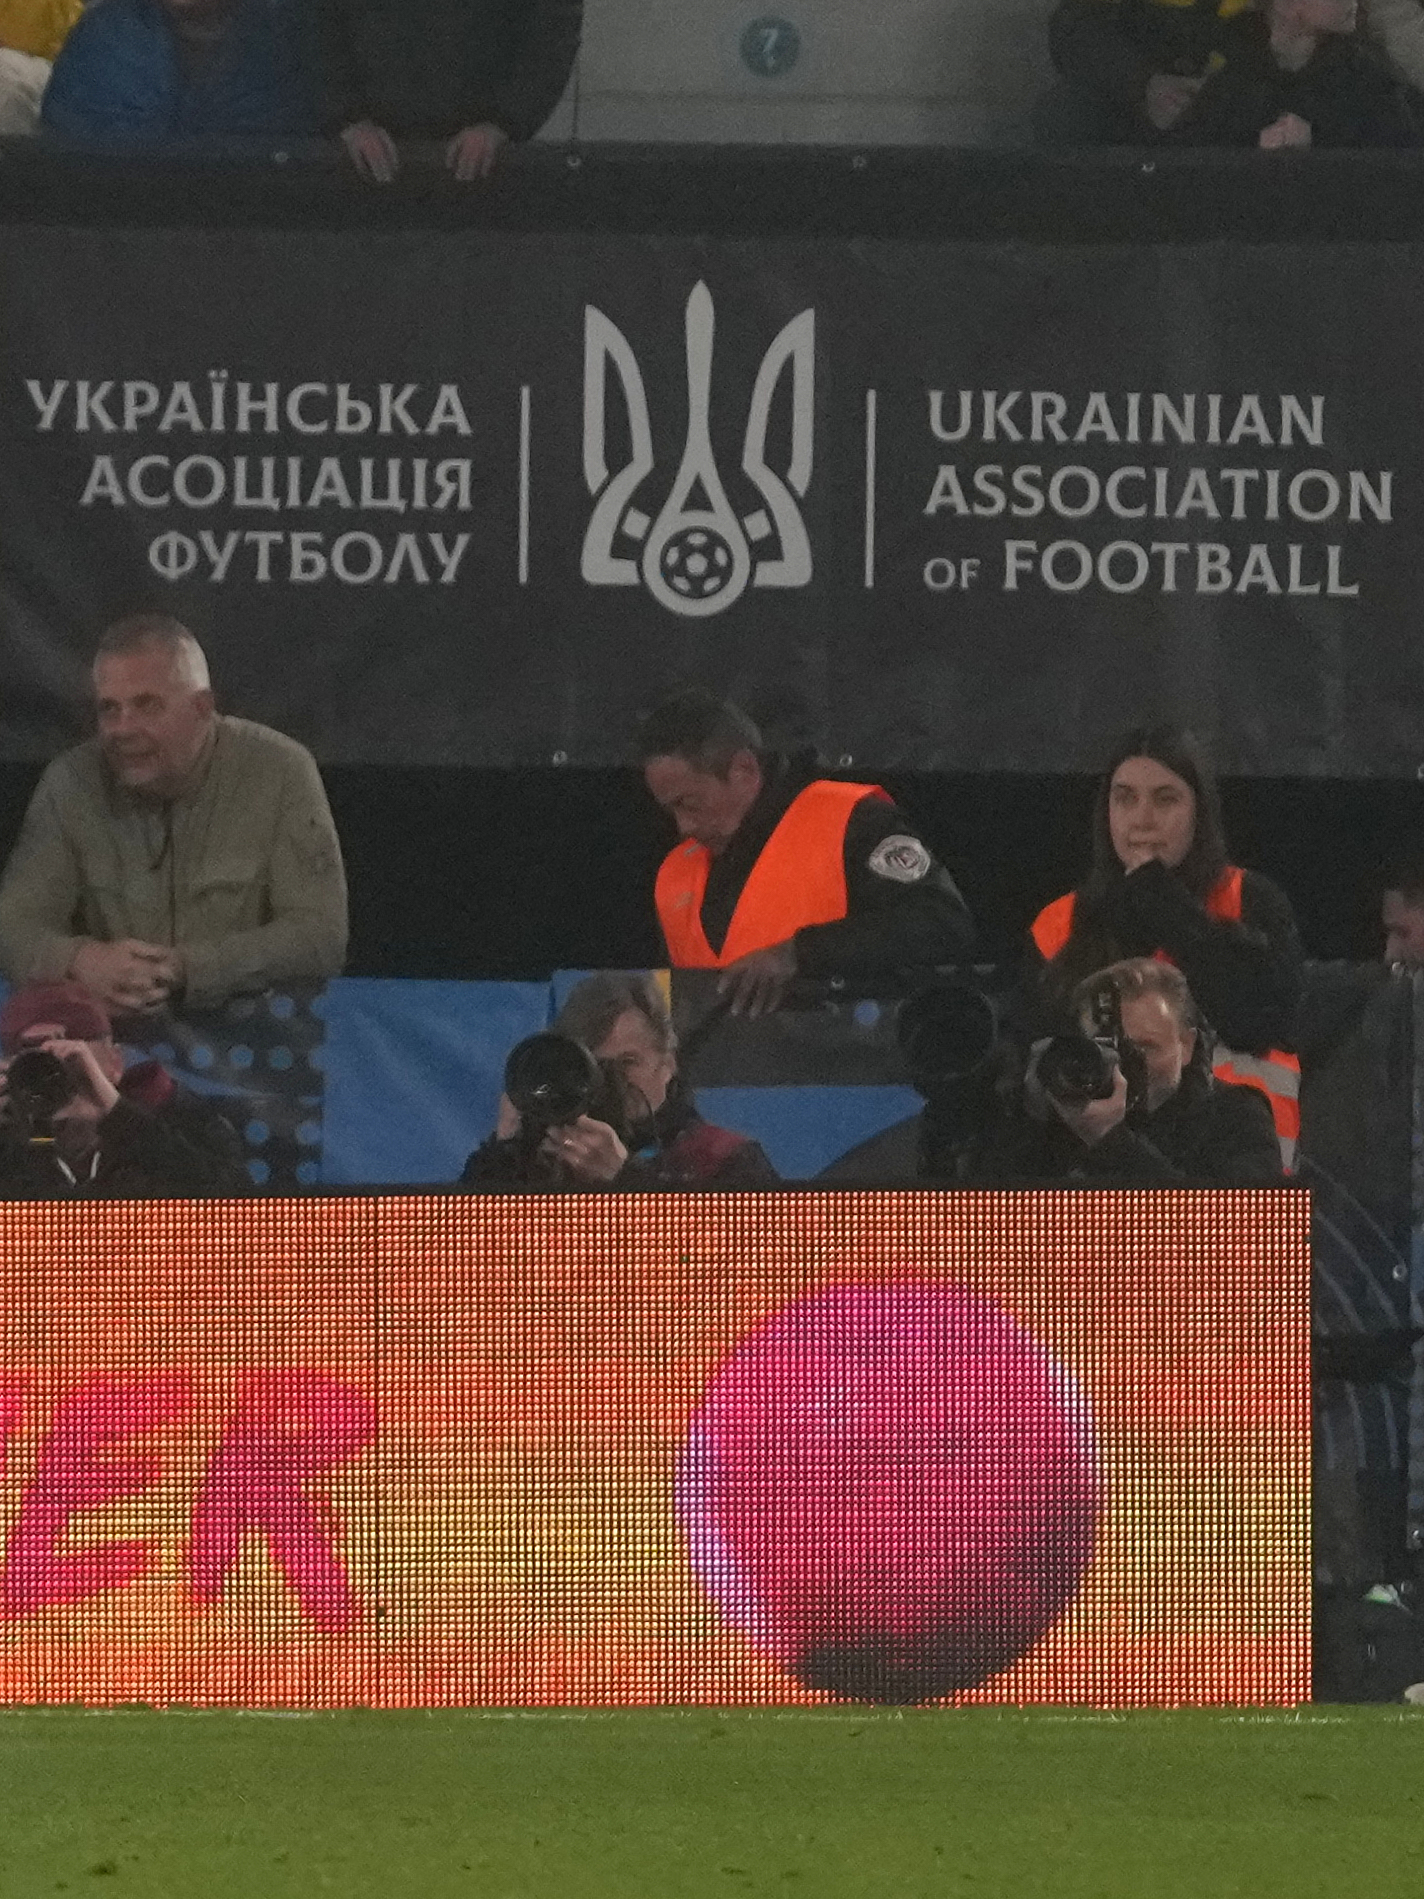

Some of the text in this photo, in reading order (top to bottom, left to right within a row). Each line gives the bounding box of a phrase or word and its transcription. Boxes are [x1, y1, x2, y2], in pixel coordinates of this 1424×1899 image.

[26, 369, 473, 436] УКРАЇНСЬКА
[928, 390, 1326, 446] UKRAINIAN
[80, 454, 473, 513] АСОЦІАЦІЯ
[923, 464, 1394, 522] ASSOCIATION
[148, 530, 471, 585] ФУТБОЛУ
[923, 539, 1360, 596] OF FOOTBALL
